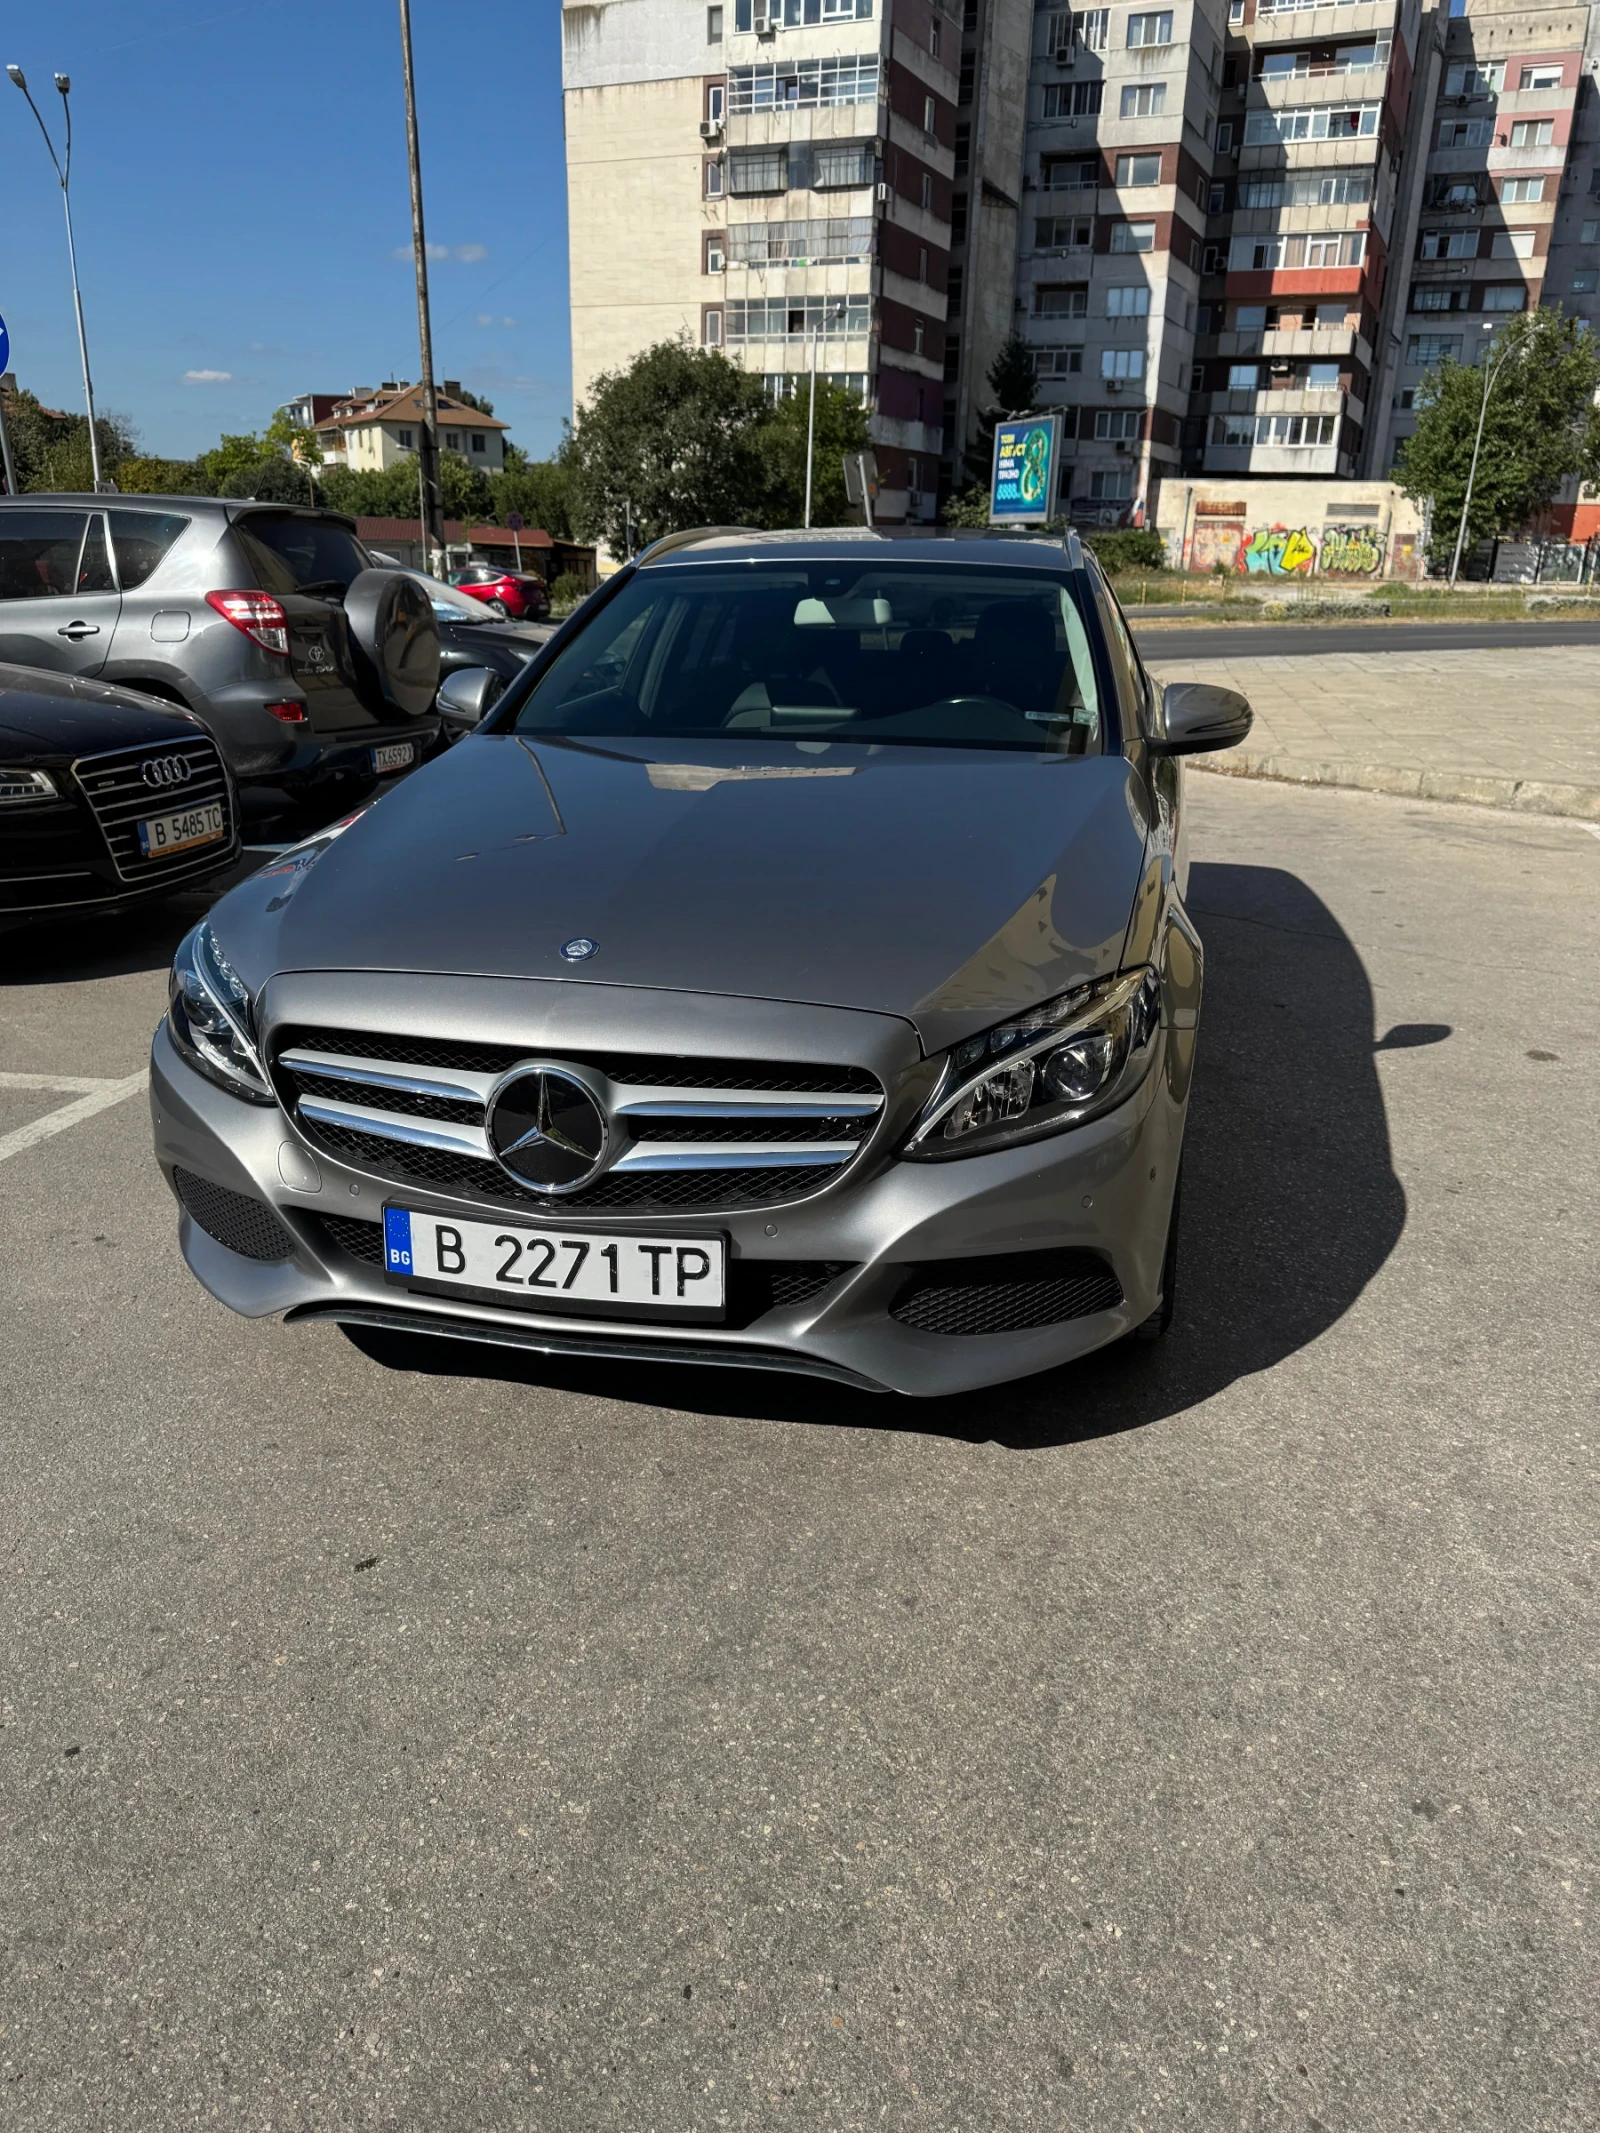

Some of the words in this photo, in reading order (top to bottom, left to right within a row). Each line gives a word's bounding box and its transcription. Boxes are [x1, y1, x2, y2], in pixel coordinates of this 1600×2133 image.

[154, 822, 167, 846] B
[171, 812, 205, 841] 5485
[205, 807, 222, 831] TC
[390, 1248, 411, 1266] BG
[435, 1223, 466, 1275] B
[494, 1234, 619, 1294] 2271
[637, 1244, 711, 1297] TP
